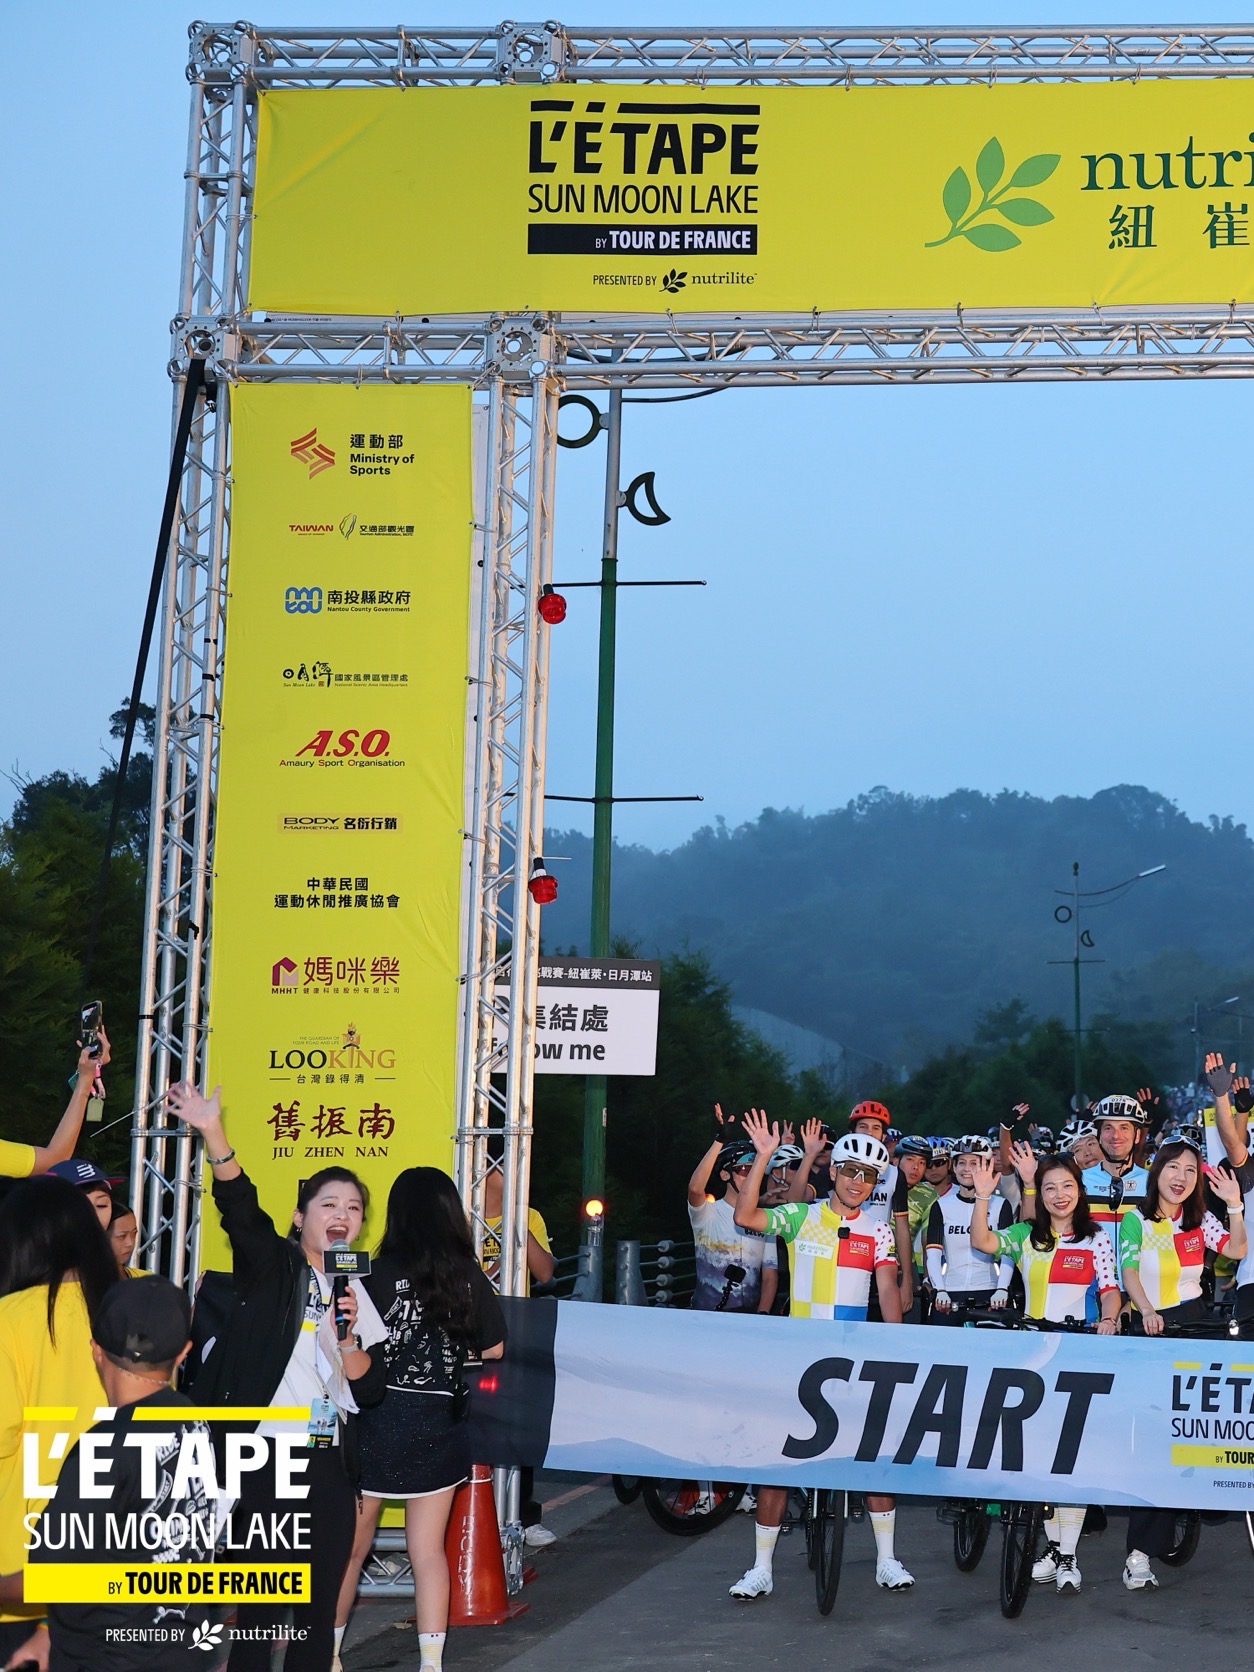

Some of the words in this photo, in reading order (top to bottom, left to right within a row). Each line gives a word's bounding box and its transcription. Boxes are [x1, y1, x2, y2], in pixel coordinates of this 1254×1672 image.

[528, 183, 585, 213] SUN
[593, 184, 682, 213] MOON
[690, 185, 758, 214] LAKE
[595, 238, 607, 249] BY
[609, 229, 655, 249] TOUR
[659, 230, 680, 249] DE
[684, 230, 751, 249] FRANCE
[593, 274, 642, 286] PRESENTED
[645, 274, 657, 286] BY
[691, 272, 755, 285] nutrilite
[350, 434, 403, 449] 運動部
[350, 454, 400, 465] Ministry
[401, 454, 415, 464] of
[350, 465, 391, 476] Sports
[327, 590, 411, 605] 南投縣政府
[295, 729, 391, 757] A.S.O.
[279, 759, 314, 768] Amaury
[318, 759, 344, 768] Sport
[348, 759, 406, 768] Organisation
[284, 817, 340, 825] BODY
[343, 817, 398, 830] 名衍行銷
[306, 877, 369, 891] 中華民國
[274, 894, 400, 908] 運動休閒推廣協會
[303, 956, 400, 986] 媽咪樂
[268, 1049, 396, 1069] LOOKING
[570, 1043, 606, 1061] me
[266, 1101, 396, 1142] 舊振南
[272, 1147, 294, 1160] JIU
[304, 1147, 345, 1158] ZHEN
[355, 1147, 389, 1158] NAN
[782, 1356, 1115, 1475] START
[1171, 1417, 1209, 1439] SUN
[1224, 1451, 1254, 1465] TOUR
[1213, 1480, 1246, 1489] PRESENTED
[1247, 1481, 1254, 1489] BY
